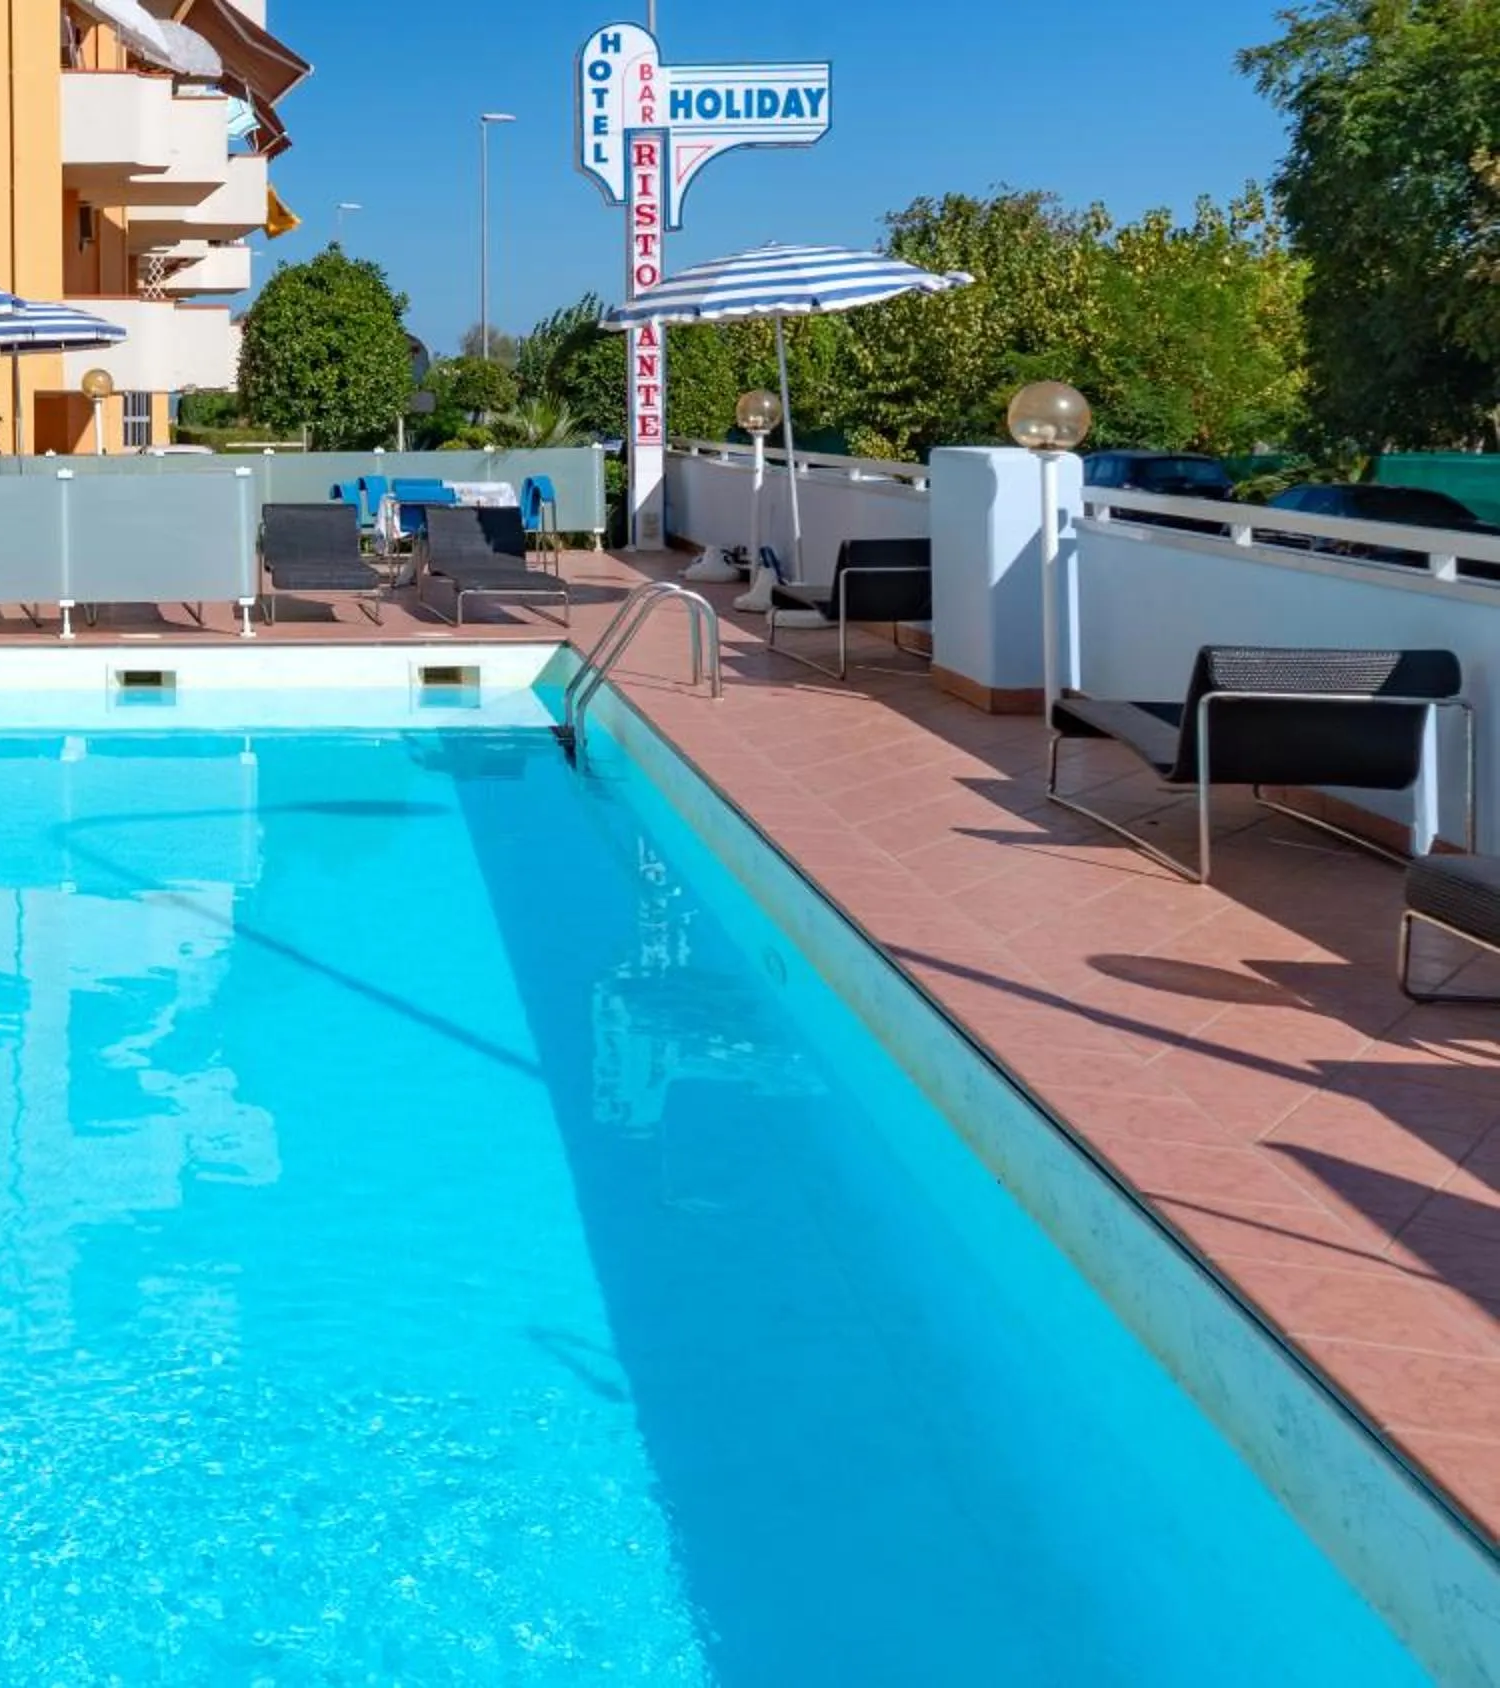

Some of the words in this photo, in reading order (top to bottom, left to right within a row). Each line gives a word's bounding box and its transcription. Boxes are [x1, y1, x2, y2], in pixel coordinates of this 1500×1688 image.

[587, 32, 621, 163] HOTEL
[638, 63, 656, 123] BAR
[669, 87, 827, 119] HOLIDAY
[632, 143, 660, 438] RISTOANTE
